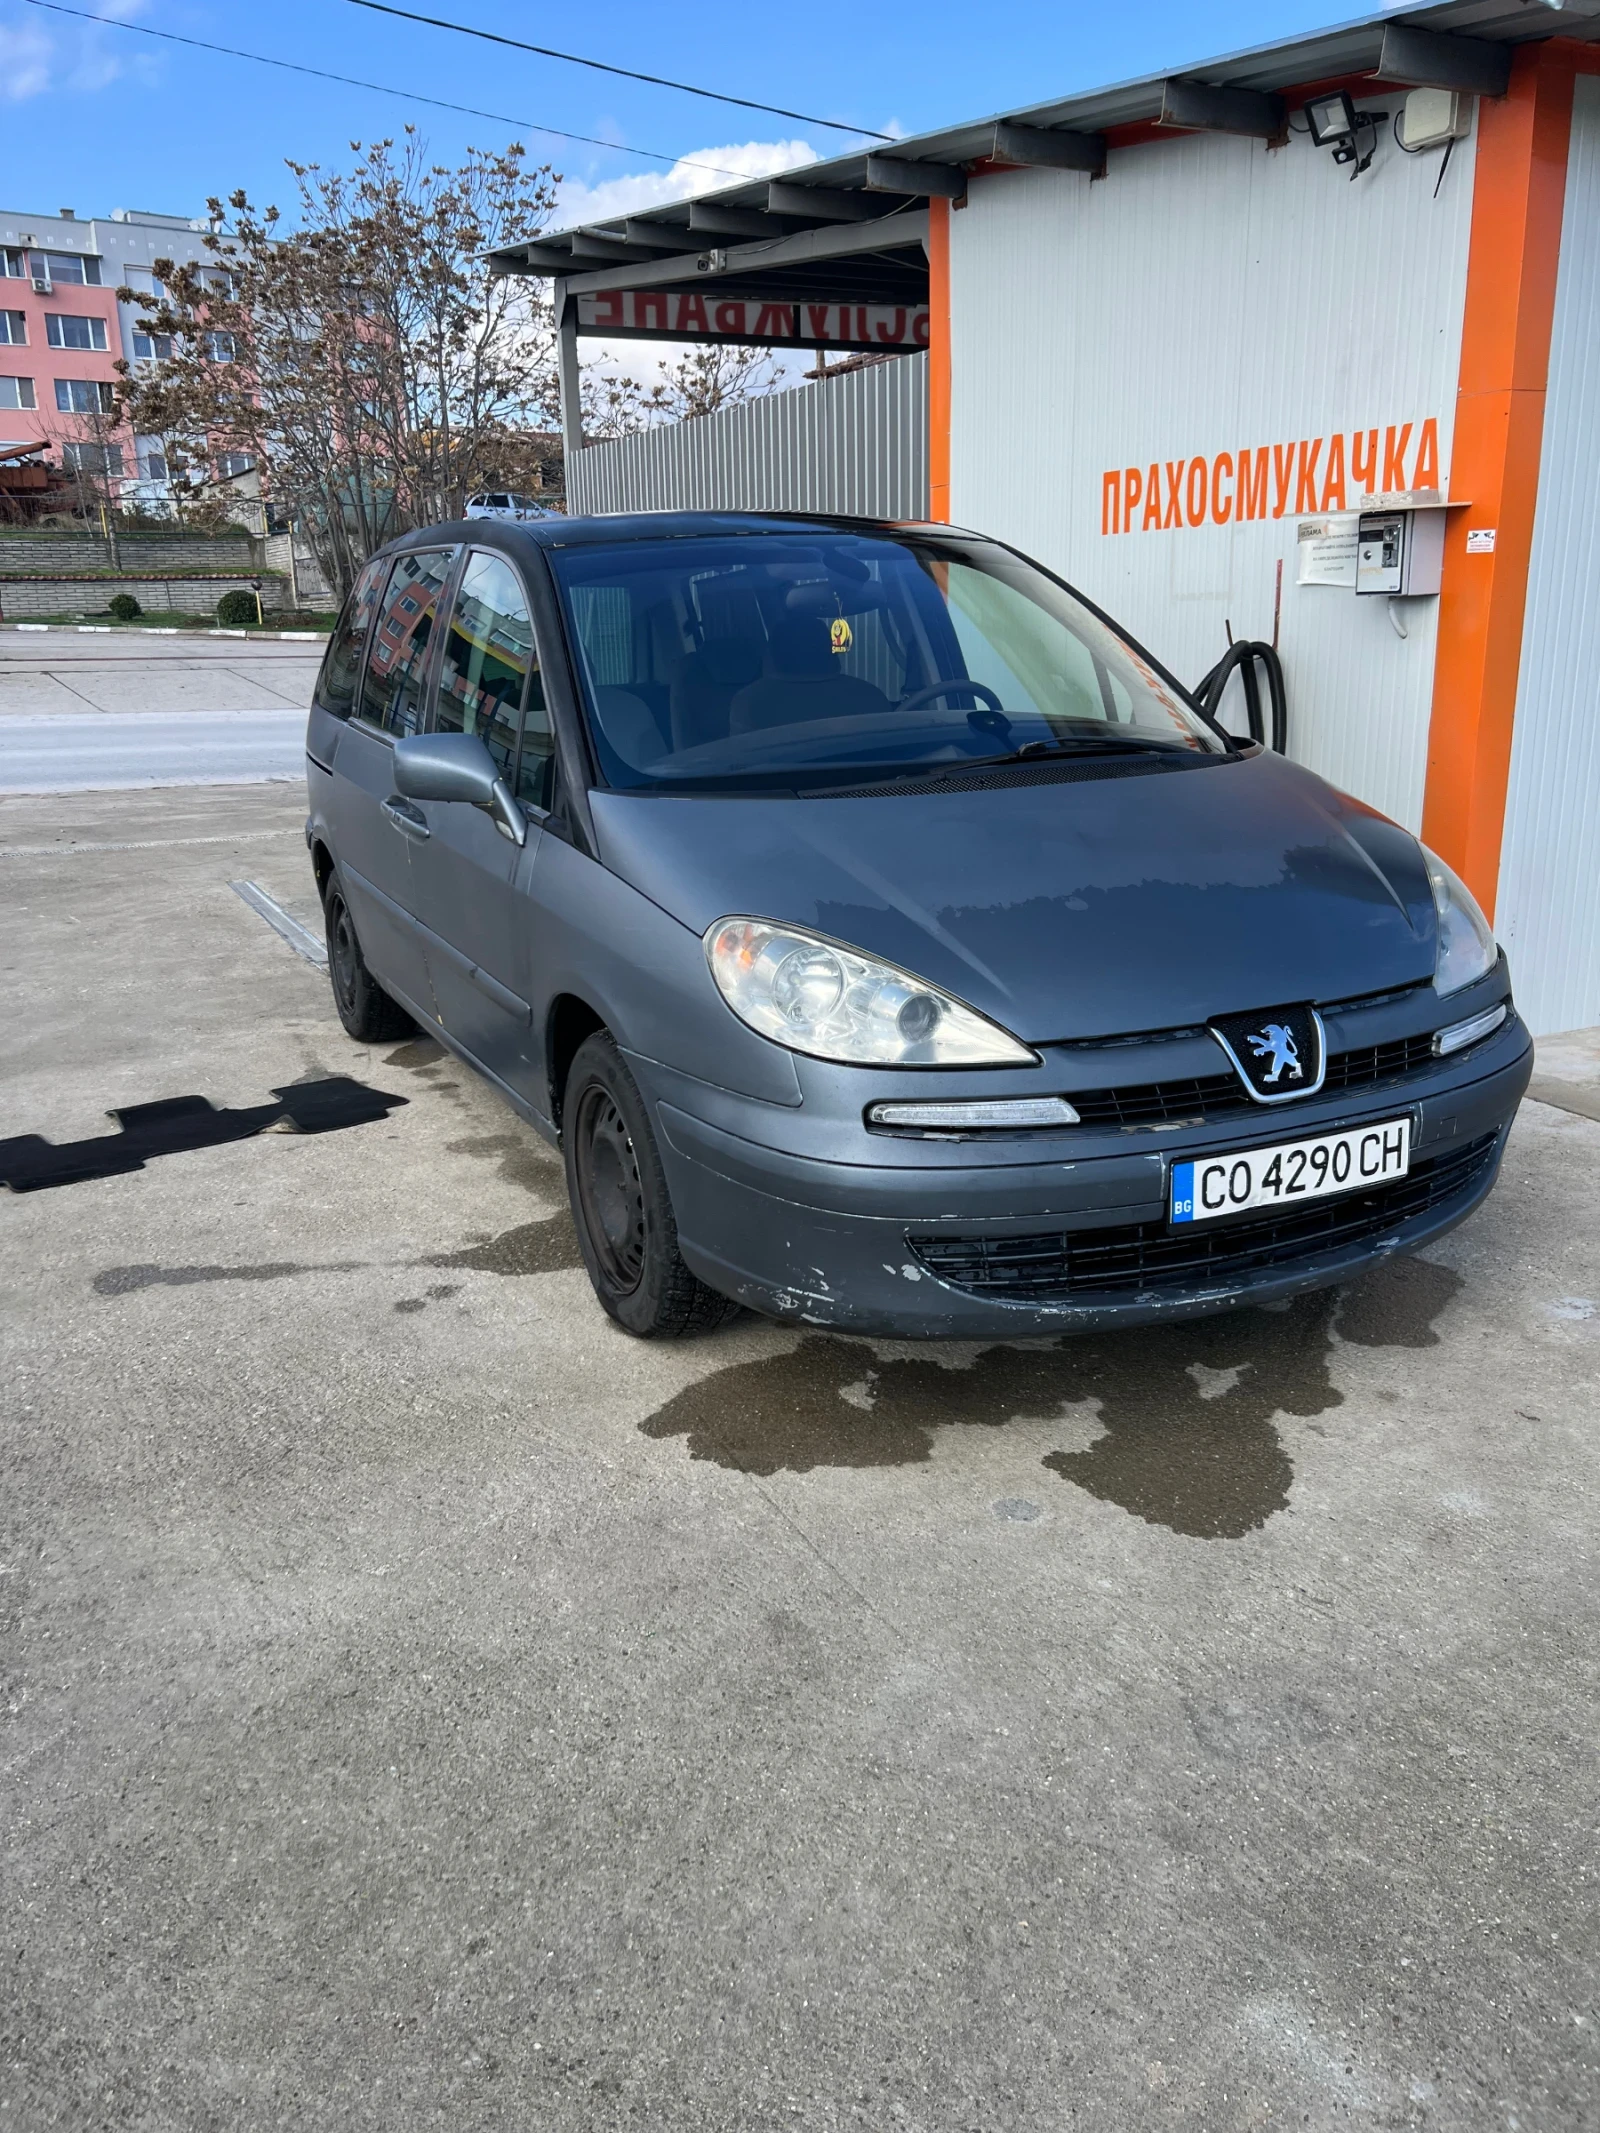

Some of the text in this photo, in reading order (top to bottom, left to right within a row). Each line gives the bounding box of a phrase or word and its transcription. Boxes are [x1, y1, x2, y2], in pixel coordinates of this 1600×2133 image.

[1101, 417, 1438, 535] ПРАХОСМУКАЧКА
[1174, 1199, 1192, 1214] BG
[1201, 1126, 1403, 1209] CO 4290 CH
